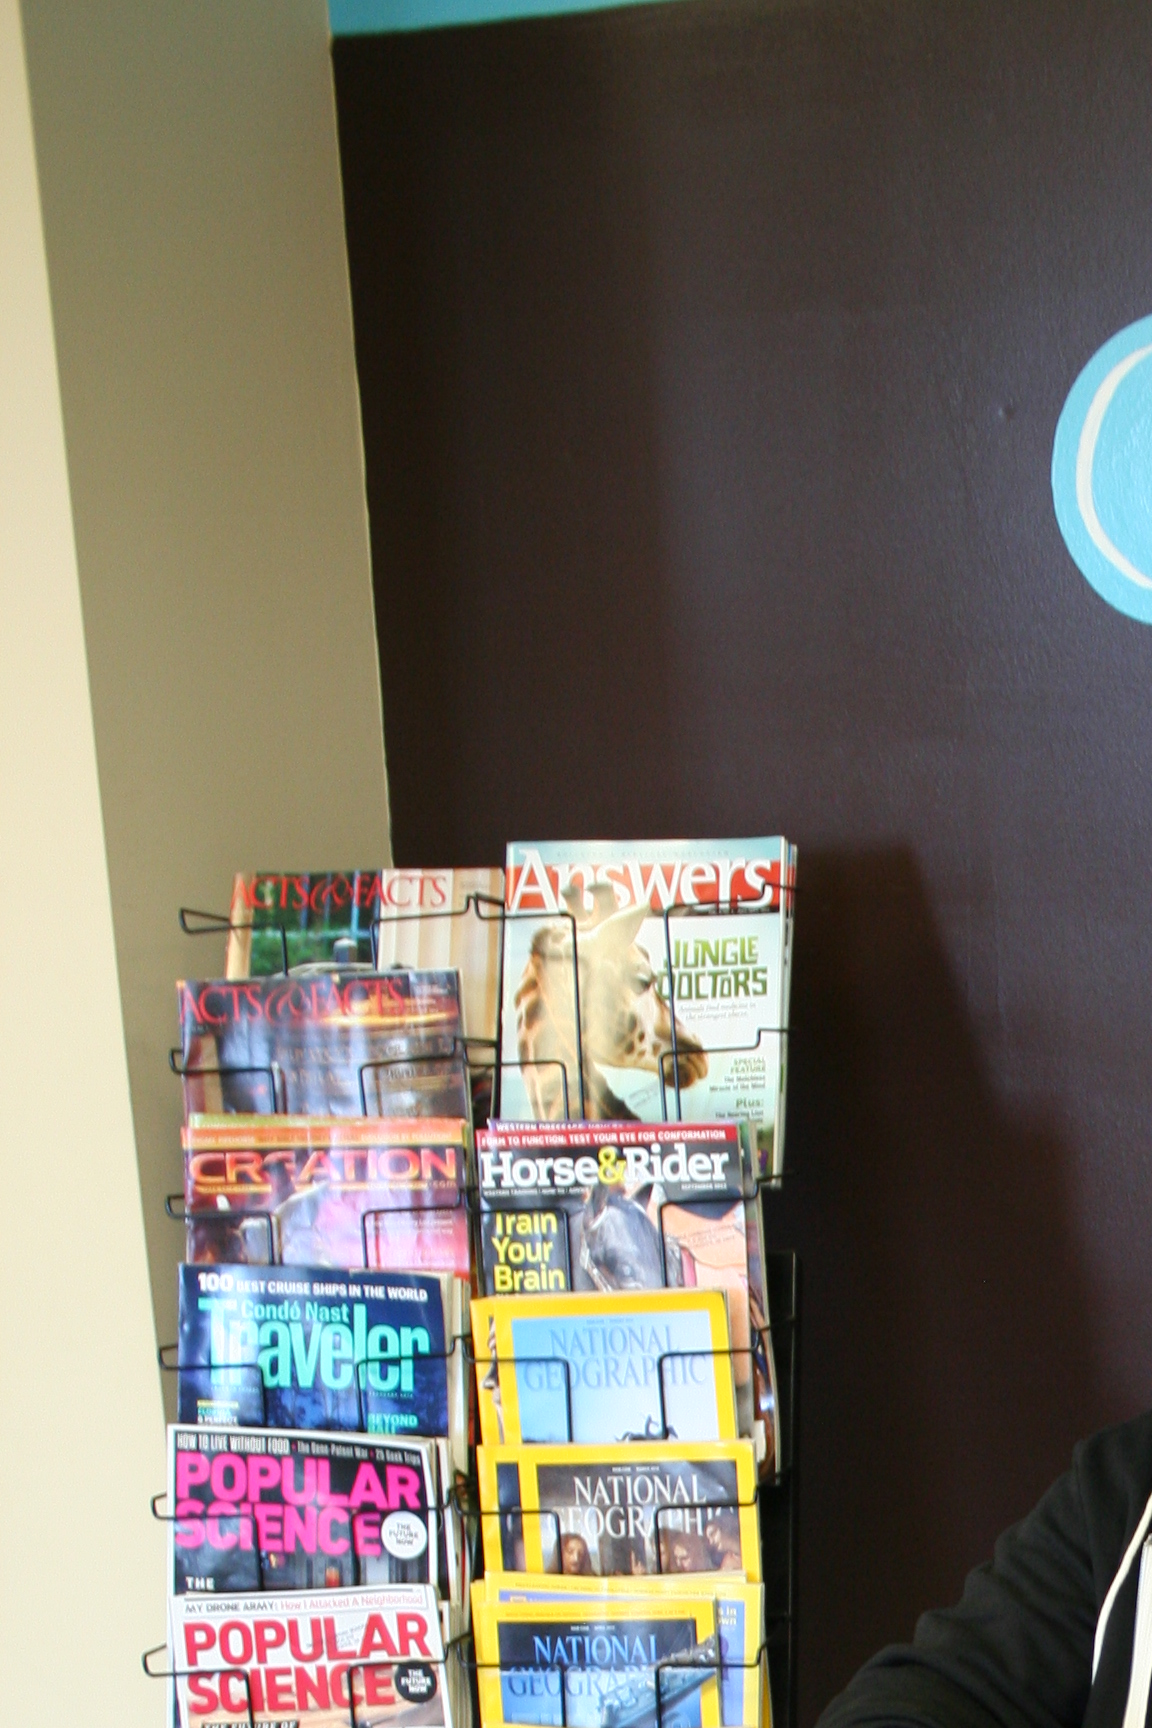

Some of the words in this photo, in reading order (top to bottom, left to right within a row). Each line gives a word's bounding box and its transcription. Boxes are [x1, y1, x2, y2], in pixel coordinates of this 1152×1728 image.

[230, 872, 310, 910] ACTS
[351, 872, 447, 907] FACTS
[506, 849, 773, 914] Answers
[664, 936, 758, 970] JUNGLE
[656, 966, 768, 1000] DOCTORS
[181, 982, 263, 1025] ACTS
[309, 979, 406, 1022] FACTS
[508, 1136, 520, 1145] TO
[569, 1133, 591, 1144] TEST
[593, 1133, 618, 1143] YOUR
[620, 1132, 635, 1142] EYE
[638, 1131, 655, 1141] FOR
[658, 1130, 726, 1140] CONFORMATION
[189, 1147, 457, 1184] CREATION
[495, 1212, 557, 1236] Train
[492, 1236, 553, 1264] Your
[198, 1272, 233, 1292] 100
[236, 1280, 265, 1293] BEST
[268, 1280, 310, 1295] CRUISE
[312, 1282, 347, 1297] SHIPS
[349, 1284, 361, 1298] IN
[364, 1285, 385, 1299] THE
[388, 1287, 428, 1300] WORLD
[494, 1266, 565, 1292] Brain
[305, 1302, 349, 1323] Nast
[198, 1297, 430, 1391] Traveler
[550, 1323, 680, 1358] NATIONAL
[523, 1353, 708, 1392] GEOGRAPHIC
[177, 1433, 197, 1450] HOW
[199, 1434, 209, 1450] TO
[210, 1434, 228, 1452] LIVE
[229, 1435, 266, 1453] WITHOUT
[267, 1437, 290, 1455] FOOD
[176, 1452, 421, 1510] POPULAR
[574, 1473, 706, 1505] NATIONAL
[174, 1500, 382, 1557] SCIENCE
[185, 1576, 214, 1591] THE
[185, 1603, 203, 1613] MY
[206, 1602, 239, 1612] DRONE
[281, 1600, 301, 1610] How
[309, 1597, 349, 1608] Attacked
[351, 1597, 358, 1606] A
[183, 1612, 432, 1666] POPULAR
[533, 1634, 656, 1664] NATIONAL
[187, 1661, 396, 1715] SCIENCE
